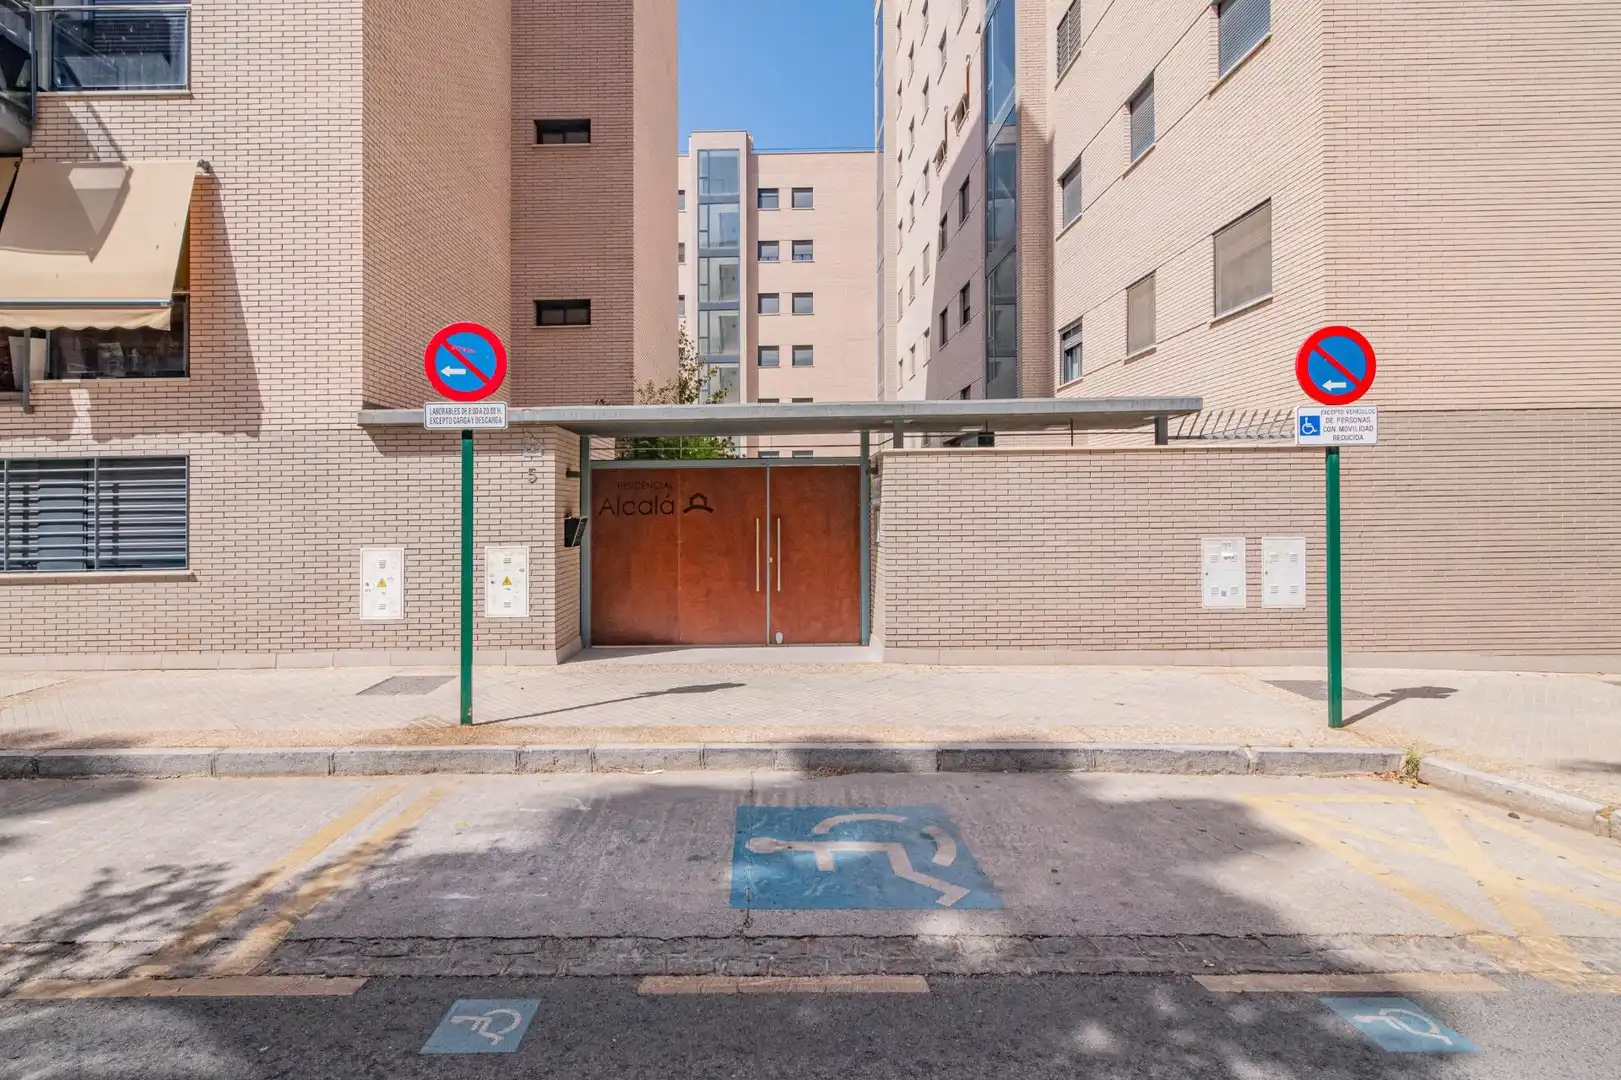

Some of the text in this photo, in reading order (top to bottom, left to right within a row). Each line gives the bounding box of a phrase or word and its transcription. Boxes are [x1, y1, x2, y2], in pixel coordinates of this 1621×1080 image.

[461, 407, 468, 415] DE
[528, 468, 538, 484] 5
[617, 480, 674, 489] RESIDENCIAL
[598, 494, 674, 516] Alcalá
